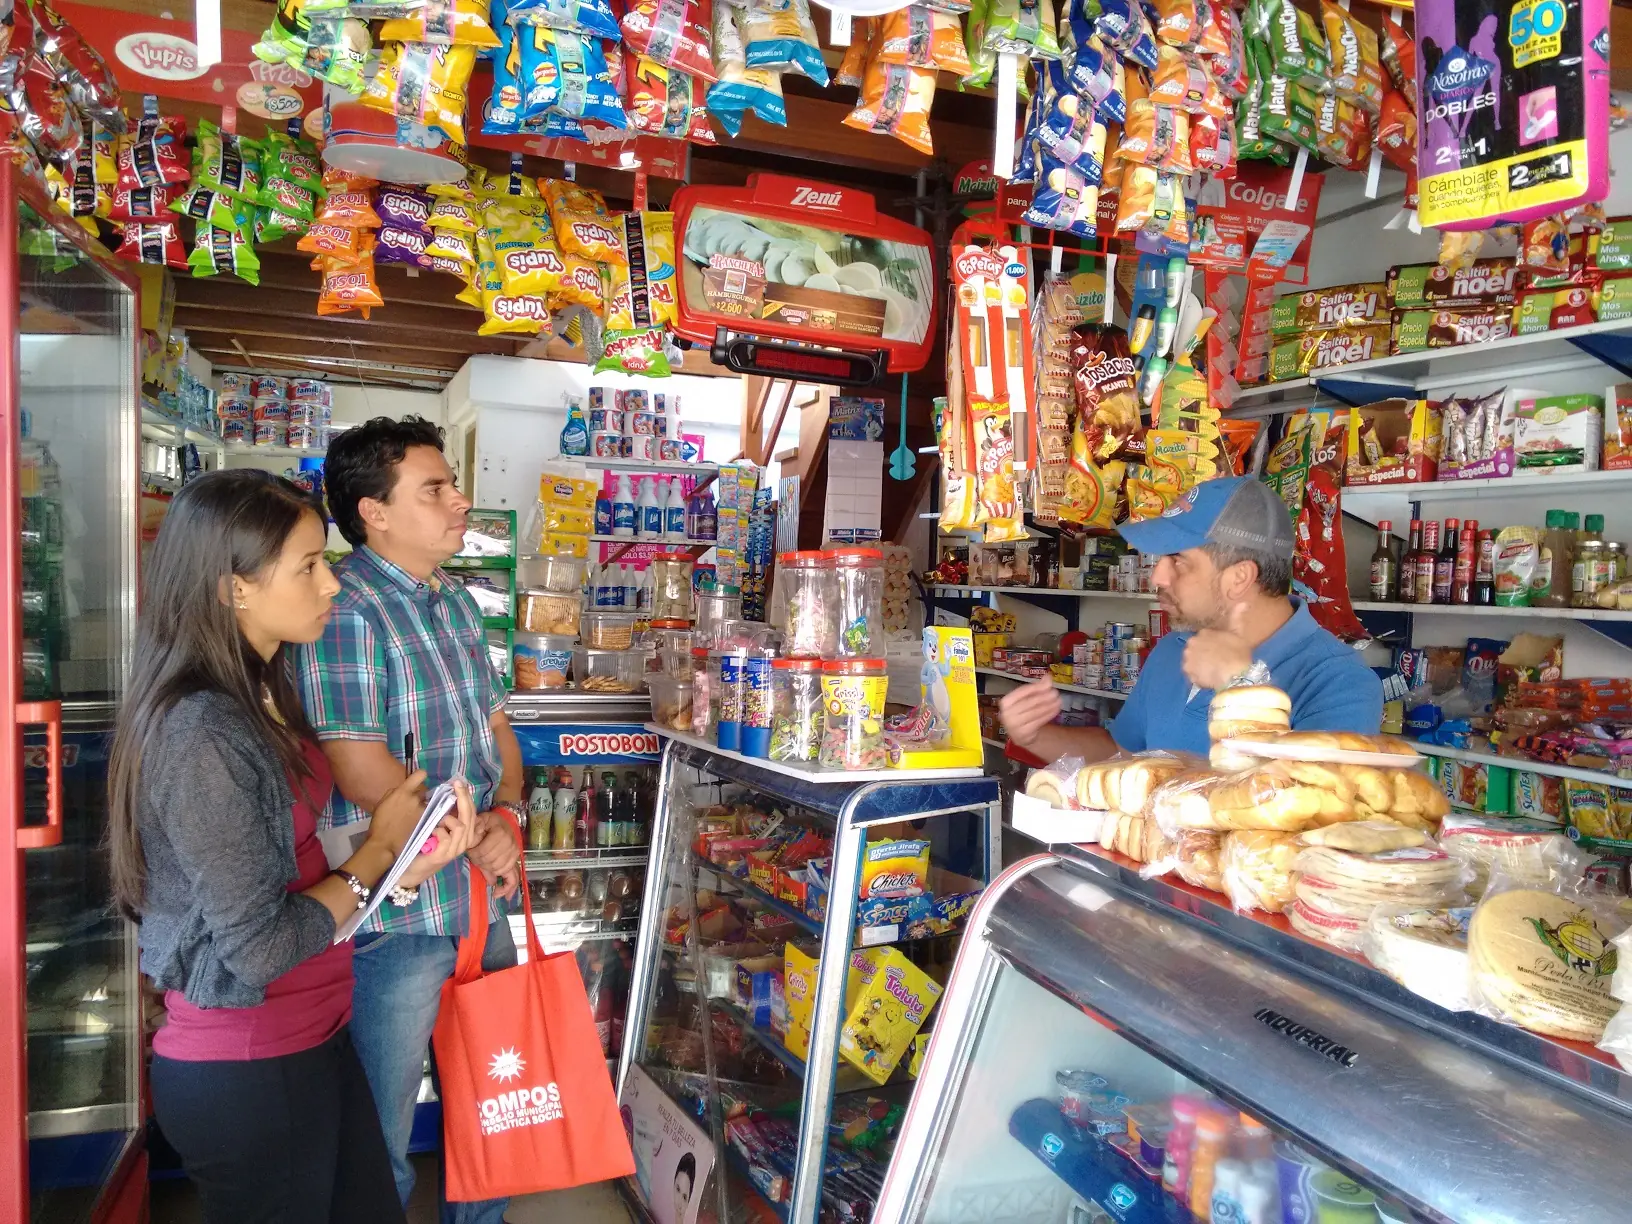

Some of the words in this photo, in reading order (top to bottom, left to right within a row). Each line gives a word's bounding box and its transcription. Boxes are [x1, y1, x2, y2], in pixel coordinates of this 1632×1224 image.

[1510, 2, 1564, 46] 50
[1515, 36, 1558, 54] PIEZAS
[134, 43, 195, 70] Yupis
[1432, 65, 1490, 92] Nosotras
[1425, 92, 1497, 123] DOBLES
[1436, 147, 1451, 165] 2
[1475, 138, 1487, 155] 1
[1511, 165, 1529, 187] 2
[1555, 154, 1569, 175] 1
[1428, 169, 1498, 194] Cámbiate
[790, 186, 842, 207] Zenú
[1007, 197, 1028, 207] para
[1230, 182, 1309, 212] Colgae
[387, 194, 430, 221] Yupis
[435, 204, 468, 220] Yupis
[383, 229, 427, 255] Yupis
[574, 224, 620, 247] Yupis
[1602, 227, 1614, 245] 5
[508, 250, 564, 274] Yupis
[710, 254, 765, 277] RANCHERA
[1400, 277, 1419, 287] Precio
[1452, 268, 1518, 297] noel
[1602, 284, 1615, 301] 5
[1396, 290, 1423, 302] Especial
[497, 297, 549, 321] Yupis
[1275, 307, 1291, 317] Precio
[1319, 293, 1377, 323] noel
[1522, 299, 1534, 315] 5
[1601, 310, 1631, 320] Ahorro
[1402, 323, 1422, 333] Precio
[1521, 324, 1548, 333] Ahorro
[1317, 336, 1373, 367] noel
[1399, 335, 1427, 348] Especial
[1277, 353, 1292, 362] Precio
[1101, 380, 1128, 394] PICANTE
[834, 407, 861, 417] Matrix
[1369, 466, 1406, 482] especial
[1458, 461, 1496, 478] especial
[1468, 656, 1497, 673] Du
[560, 734, 659, 755] POSTOBON
[871, 871, 917, 890] Chiclets
[885, 974, 924, 1014] Trululu
[477, 1082, 561, 1119] OMPOS
